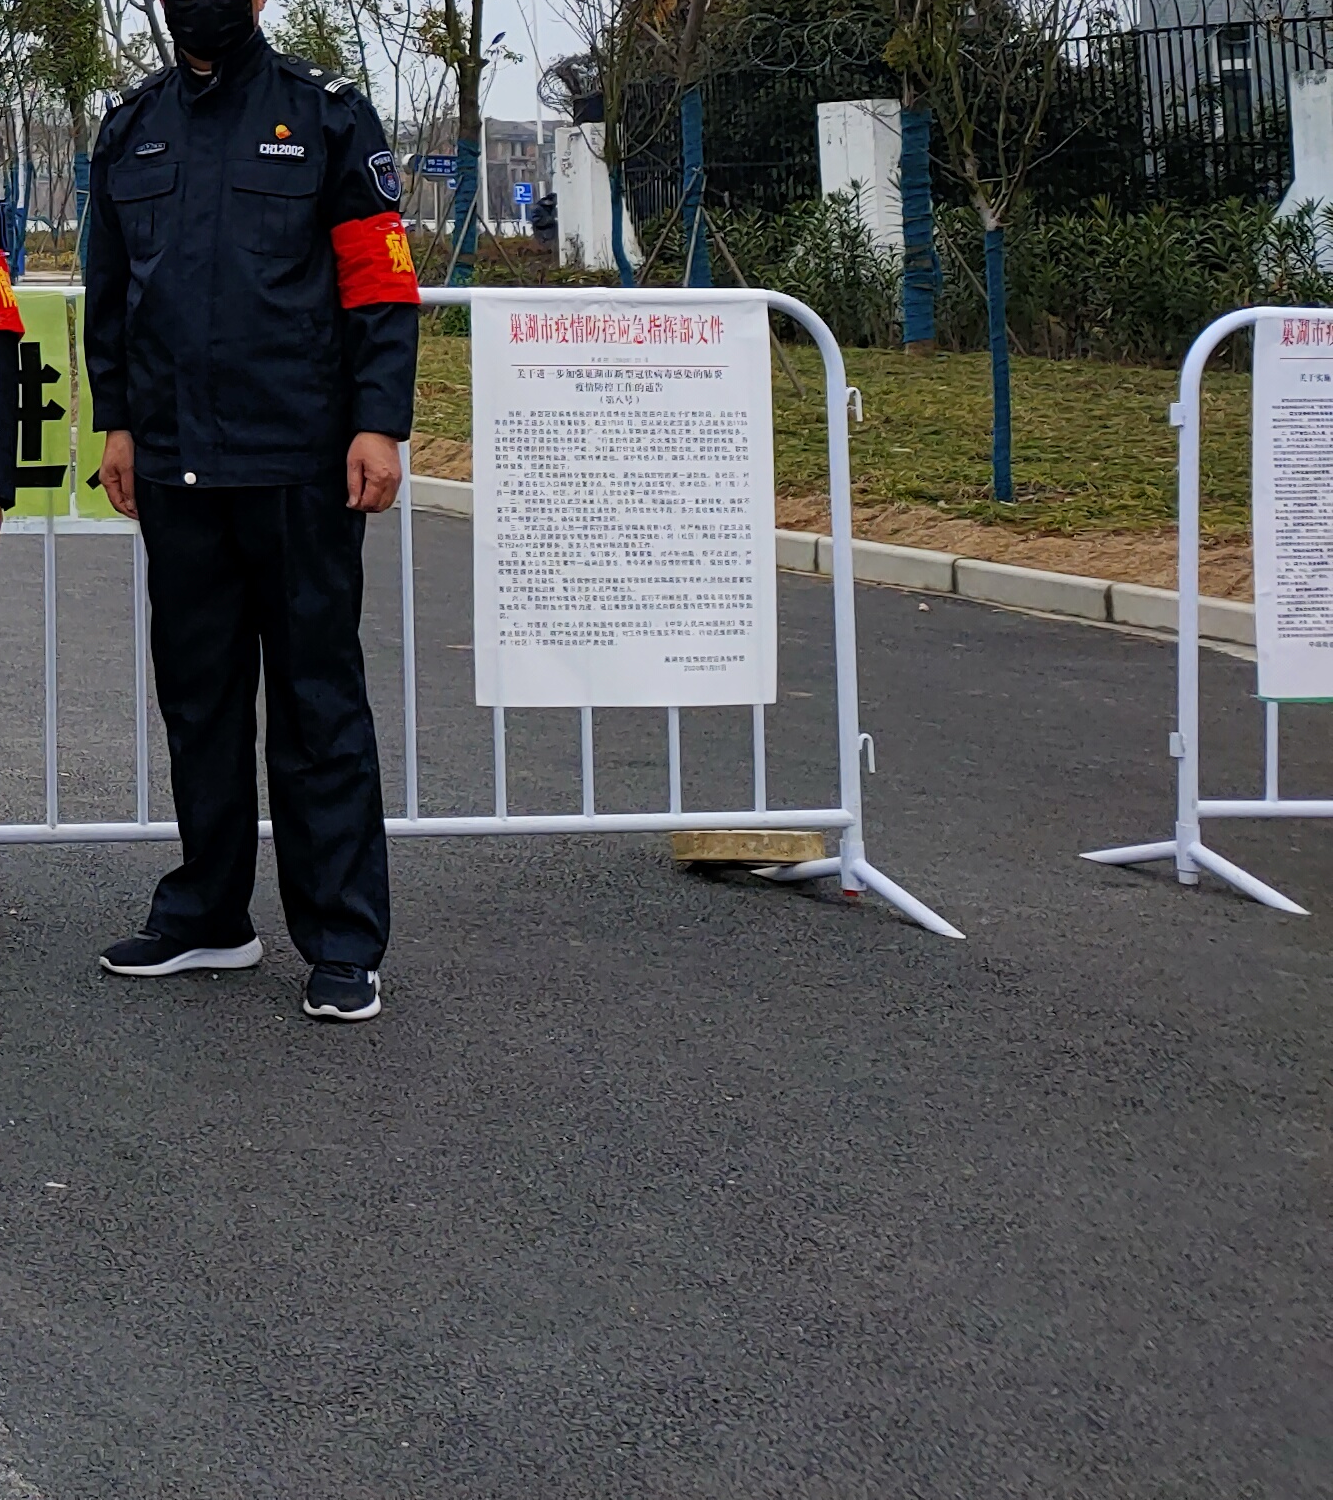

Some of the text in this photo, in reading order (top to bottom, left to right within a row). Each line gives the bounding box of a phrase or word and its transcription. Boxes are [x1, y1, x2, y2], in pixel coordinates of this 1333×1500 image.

[509, 313, 725, 346] 巢湖市疫情防控应急指挥部文件
